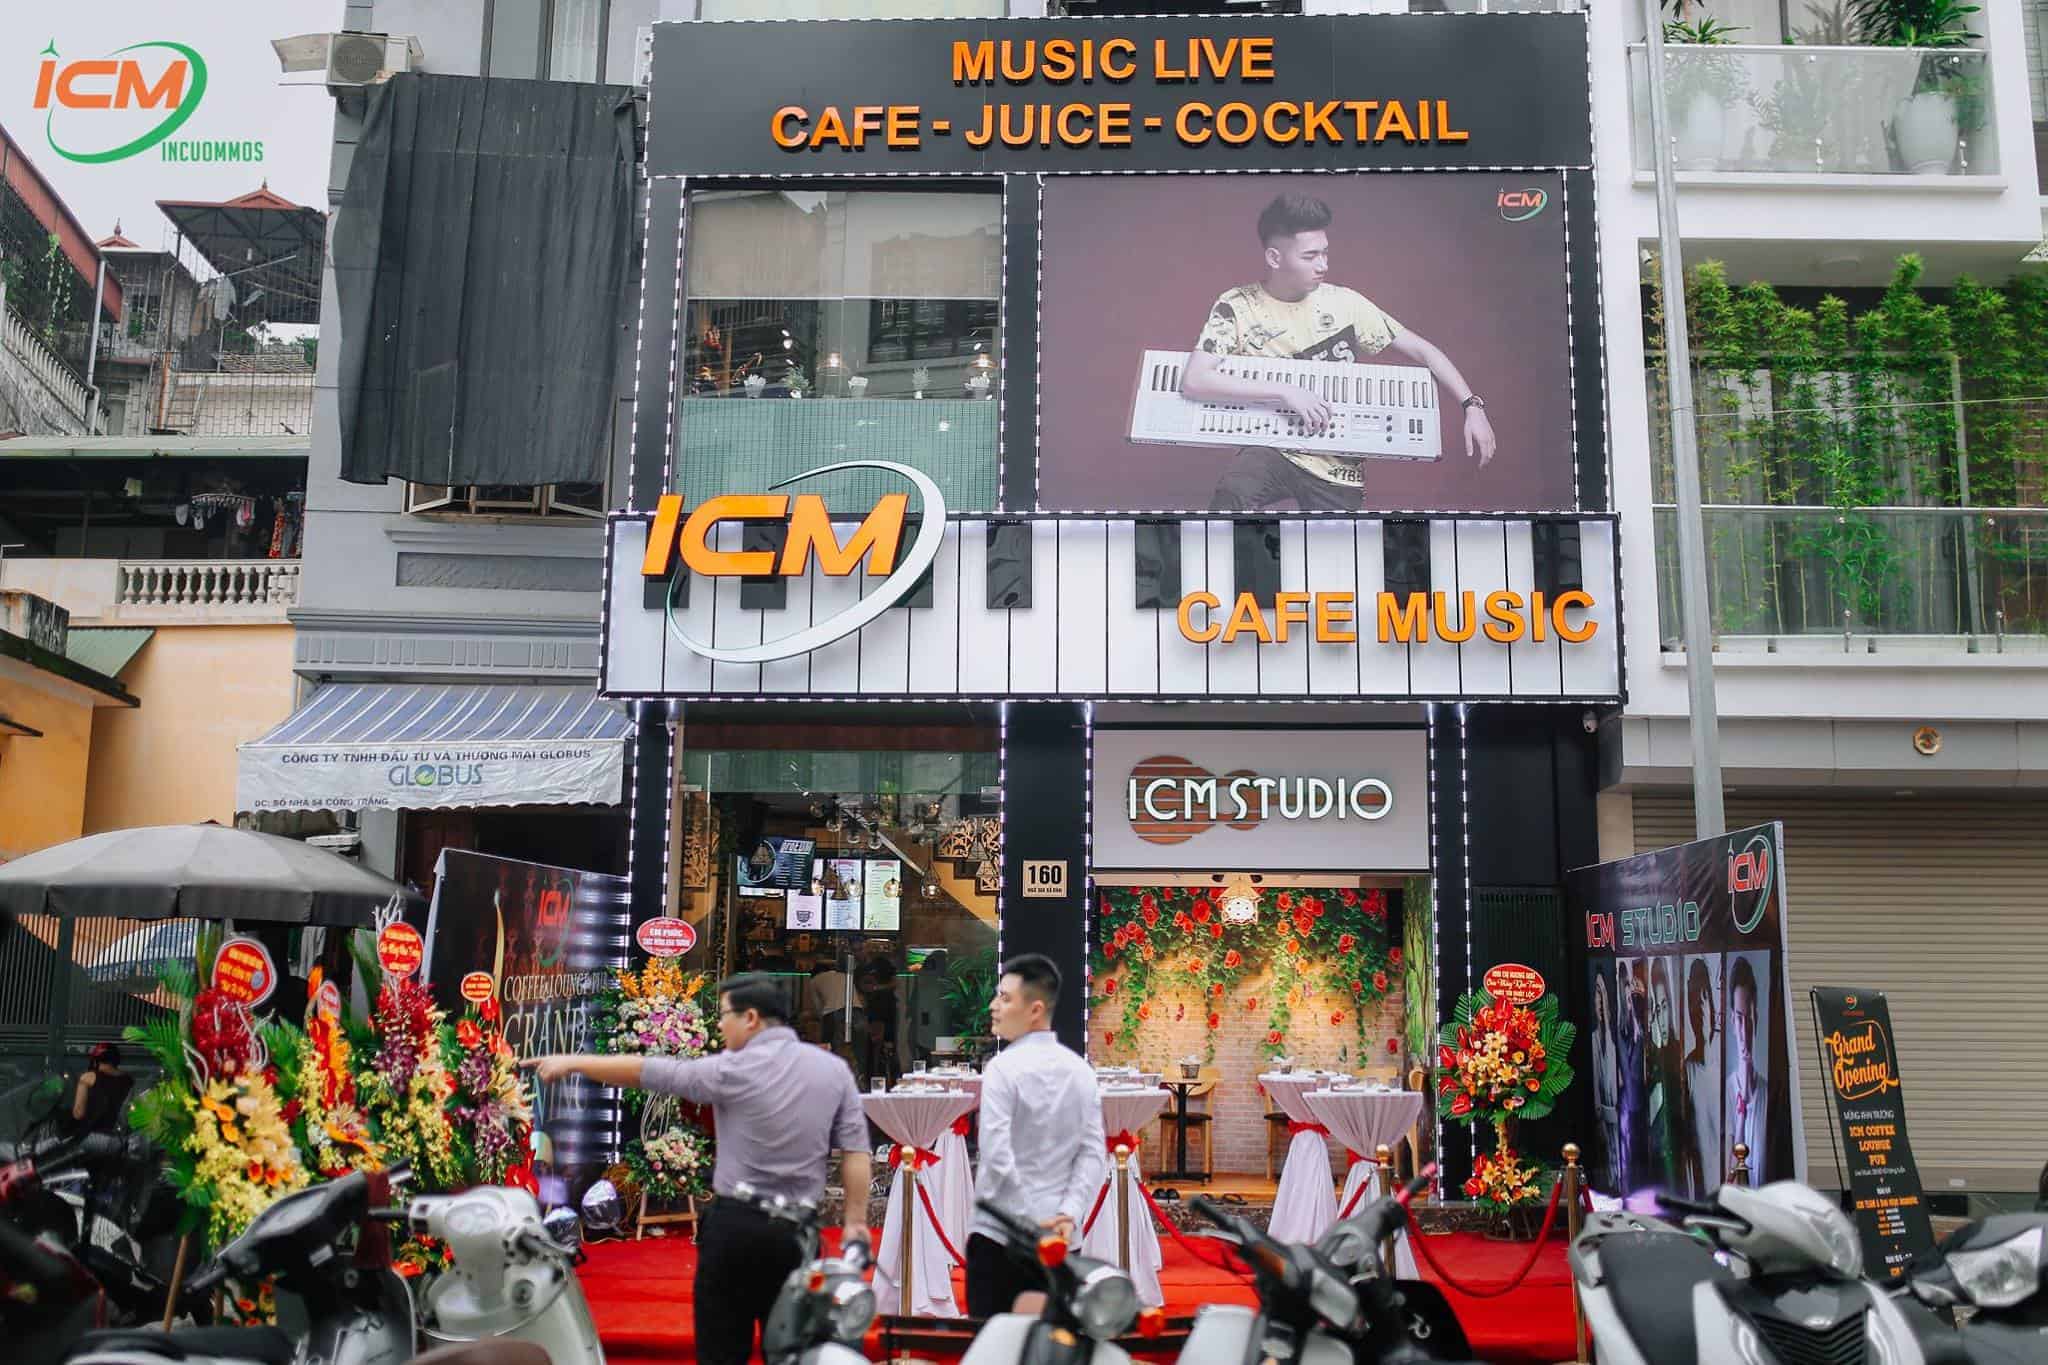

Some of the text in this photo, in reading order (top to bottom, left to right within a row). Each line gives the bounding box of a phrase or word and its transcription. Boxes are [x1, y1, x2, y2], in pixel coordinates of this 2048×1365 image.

[952, 37, 1275, 82] MUSIC LIVE
[771, 105, 921, 149] CAFE
[965, 103, 1133, 147] JUICE
[1175, 100, 1471, 144] COCKTAIL
[641, 493, 910, 577] ICM
[1176, 590, 1599, 644] CAFE MUSIC
[281, 751, 319, 764] CÔNG
[322, 752, 339, 763] TY
[343, 752, 377, 763] TNHH
[540, 749, 592, 760] GLOBUS
[388, 763, 484, 787] GLOBUS
[1128, 776, 1394, 822] ICM STUDIO
[1028, 864, 1063, 885] 160
[1728, 848, 1769, 894] ICM
[1586, 897, 1701, 952] ICM STUDIO
[1824, 1023, 1877, 1065] Grand
[1833, 1057, 1899, 1094] Opening
